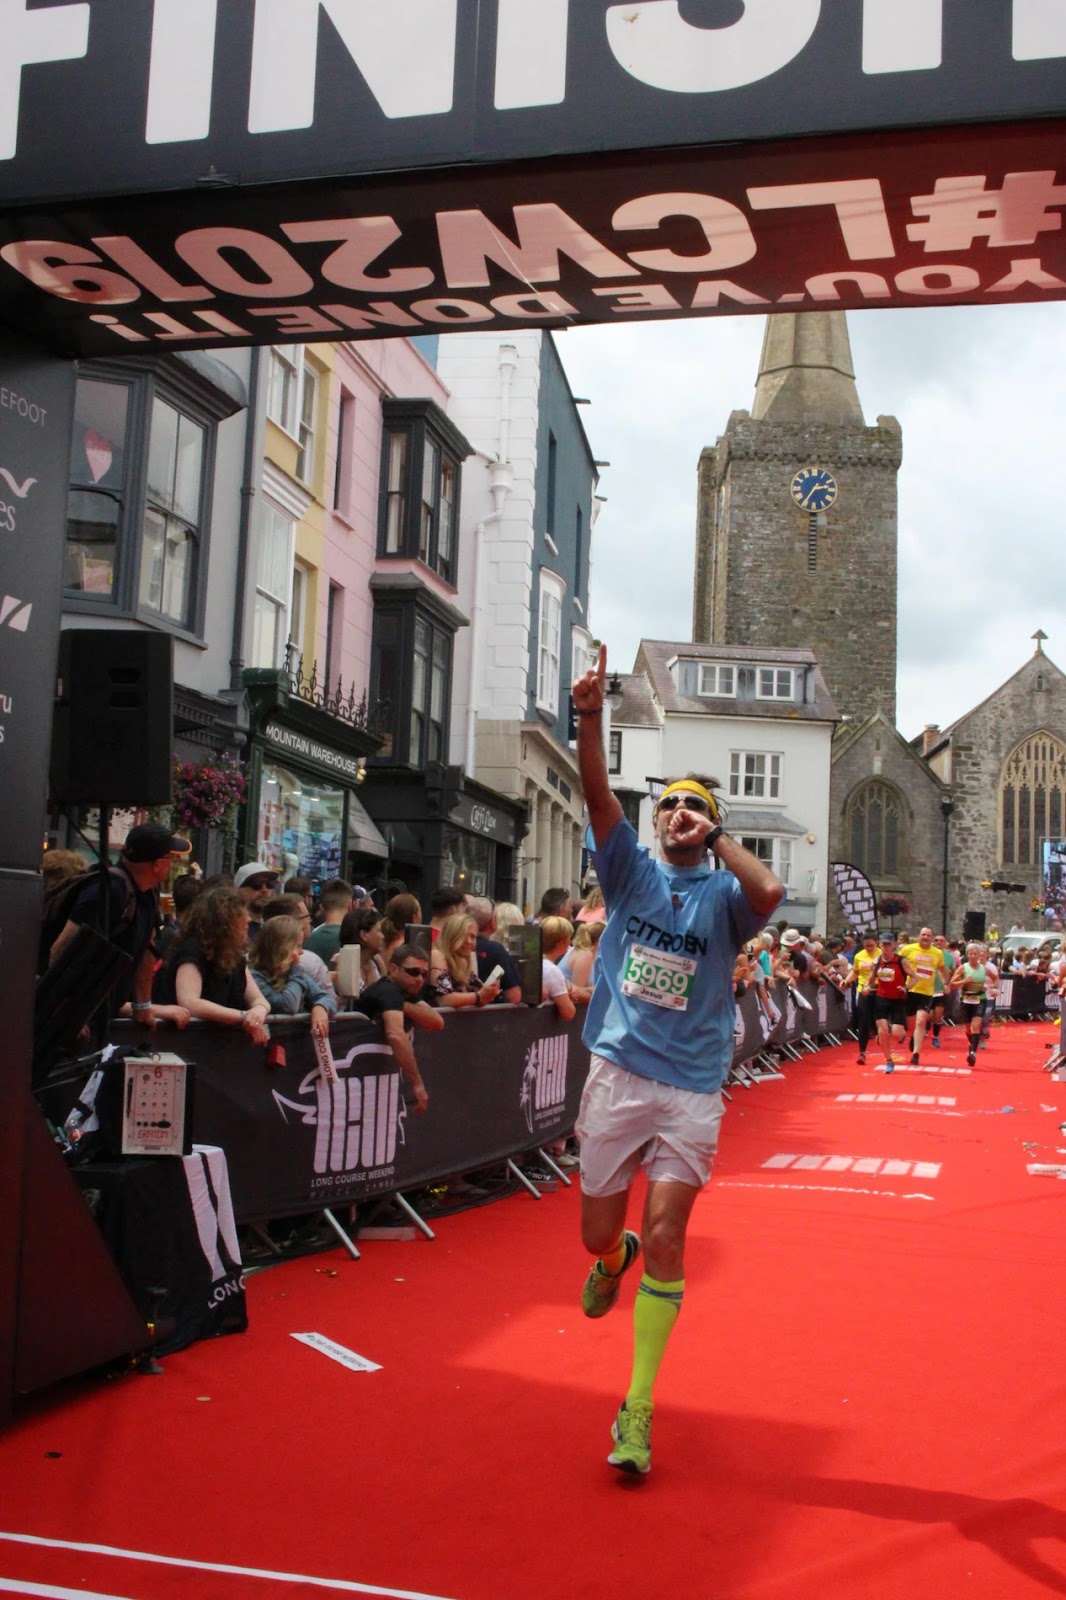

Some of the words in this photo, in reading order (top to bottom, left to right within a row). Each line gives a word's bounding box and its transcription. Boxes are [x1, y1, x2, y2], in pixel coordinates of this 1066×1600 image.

[591, 257, 1066, 313] YOU'VE
[88, 309, 254, 342] IT!
[245, 290, 581, 335] DONE
[265, 724, 310, 755] MOUNTAIN
[310, 743, 357, 775] WAREHOUSE
[627, 959, 689, 996] 5969
[640, 988, 663, 1000] Jesus
[154, 1066, 163, 1079] 6
[310, 1178, 334, 1188] LONG
[334, 1171, 367, 1185] COURSE
[367, 1165, 395, 1180] WEEKEND
